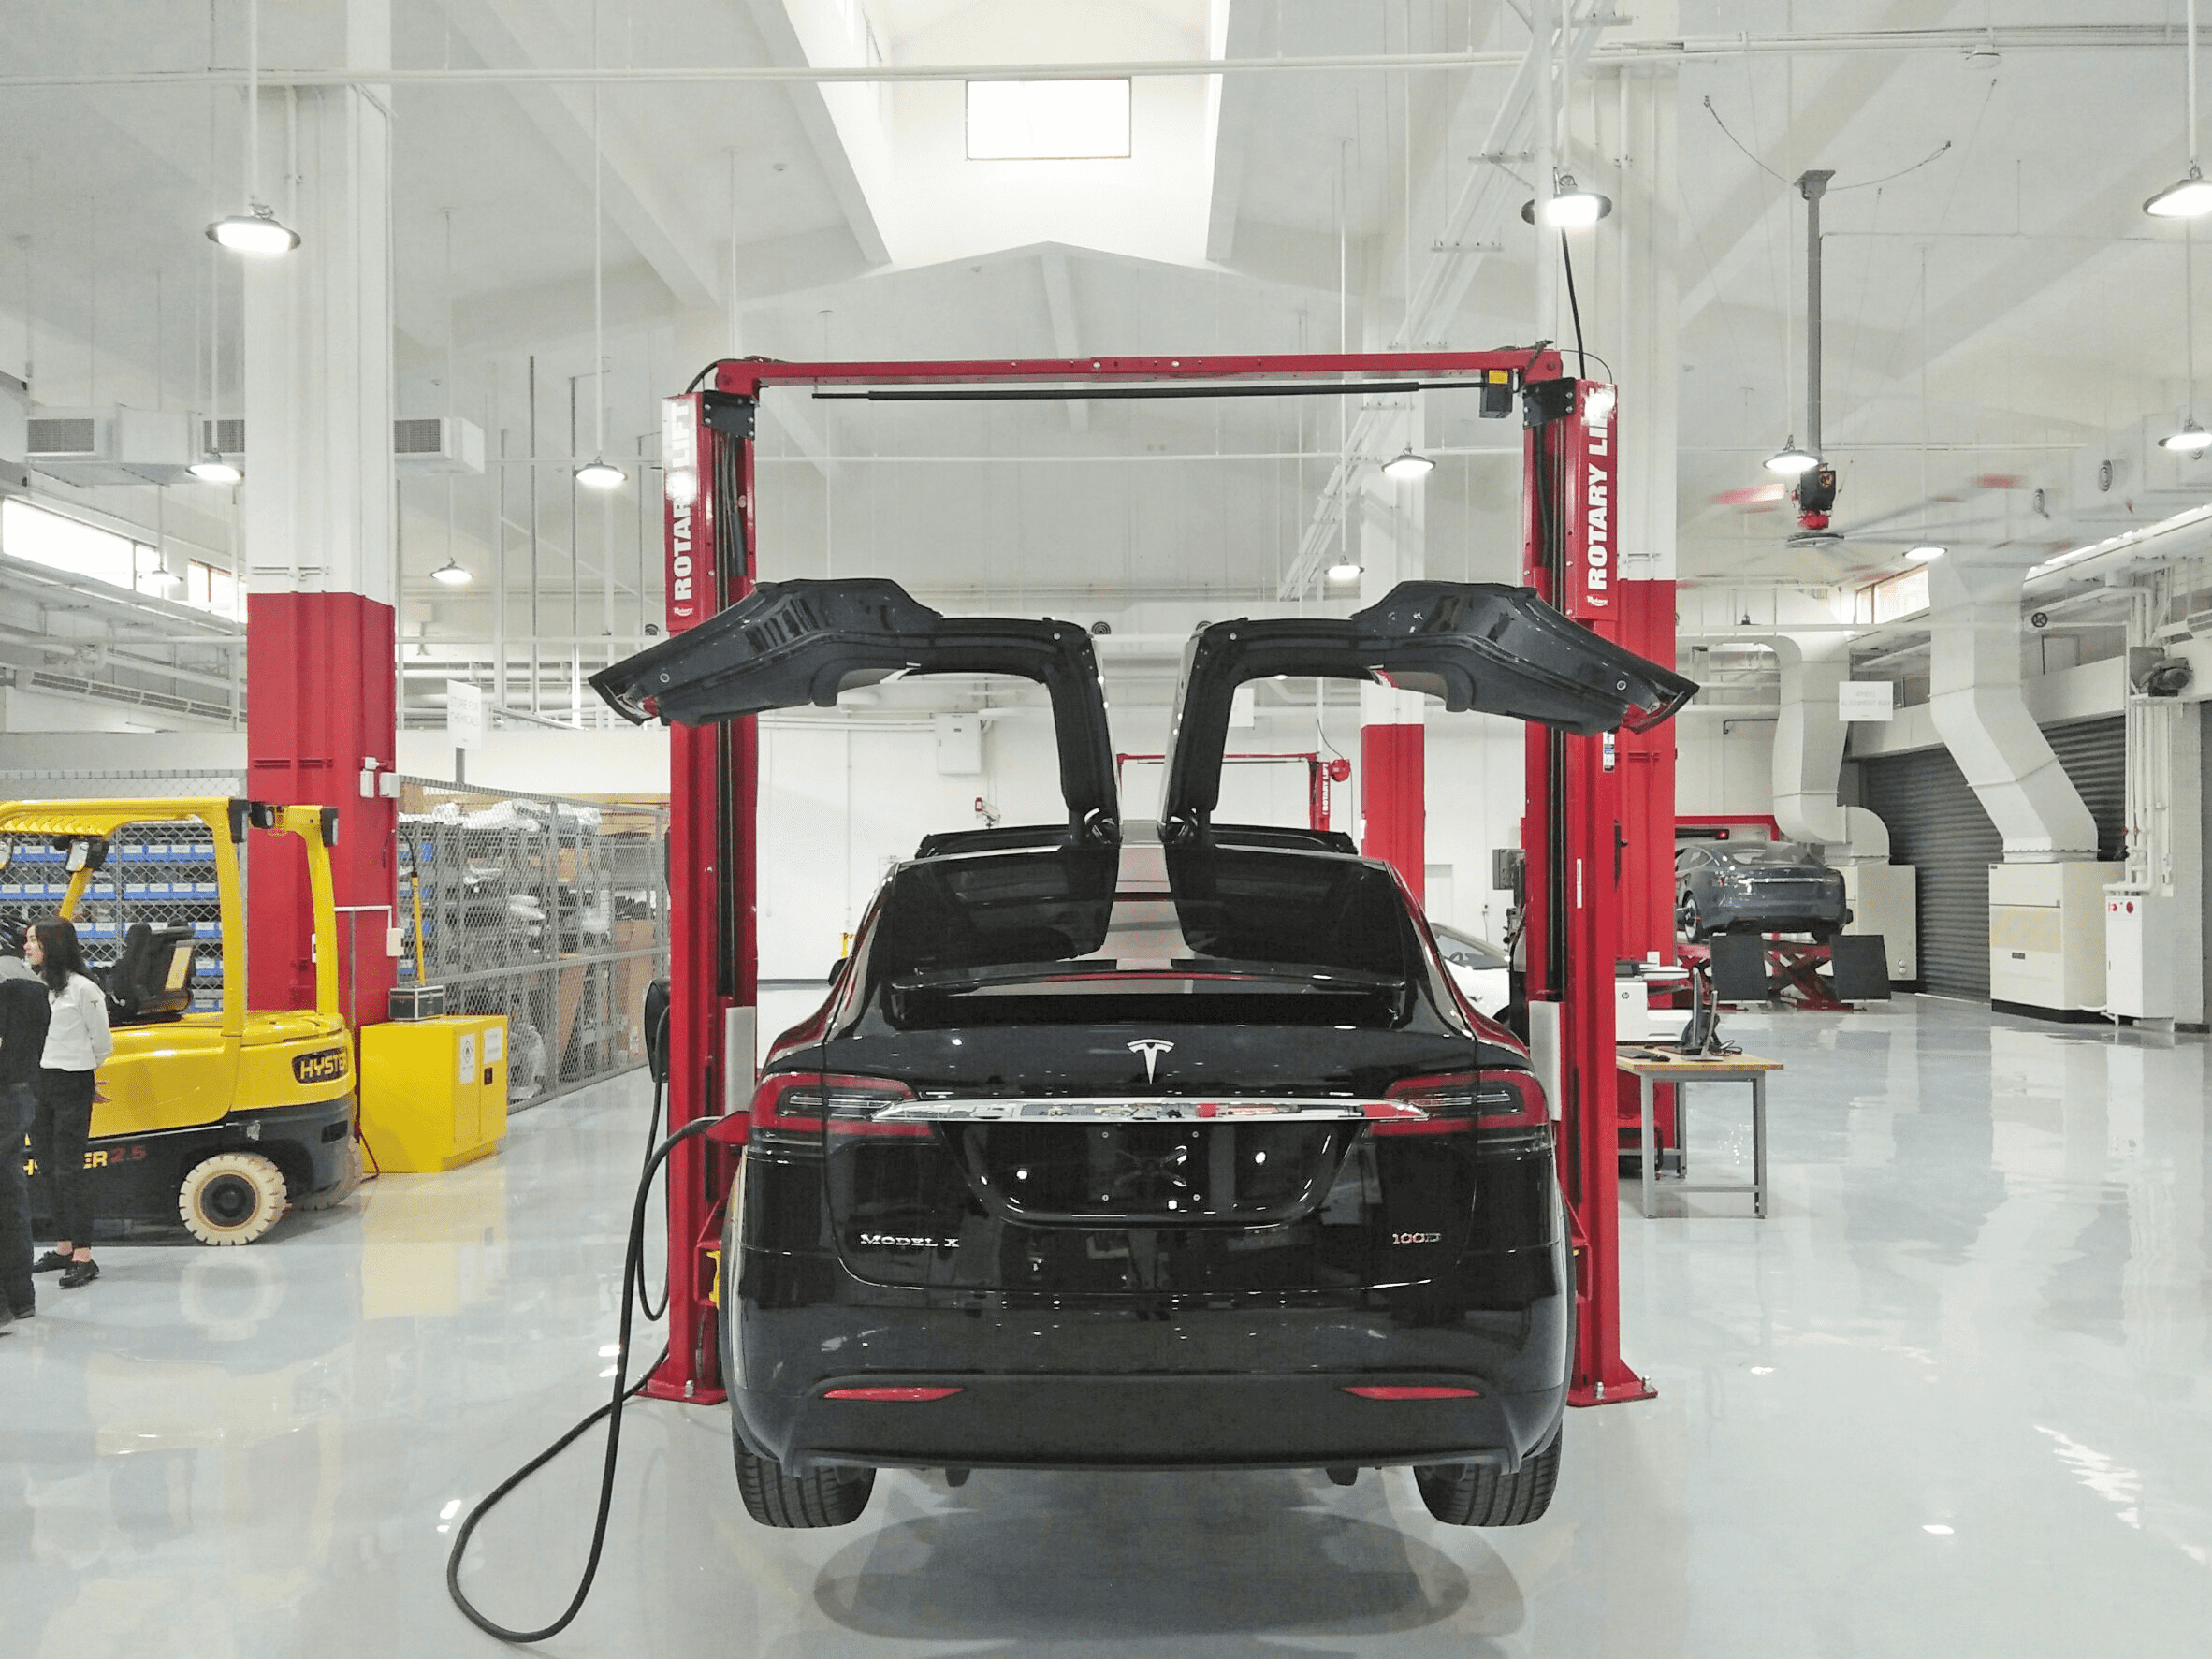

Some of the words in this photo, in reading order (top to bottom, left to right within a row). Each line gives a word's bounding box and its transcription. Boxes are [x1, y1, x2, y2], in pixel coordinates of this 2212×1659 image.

[671, 402, 691, 468] LIFT
[673, 479, 692, 601] ROTAR
[1588, 462, 1608, 590] ROTARY
[860, 1234, 939, 1247] MODEL
[944, 1238, 960, 1247] X
[1392, 1232, 1441, 1244] 100D
